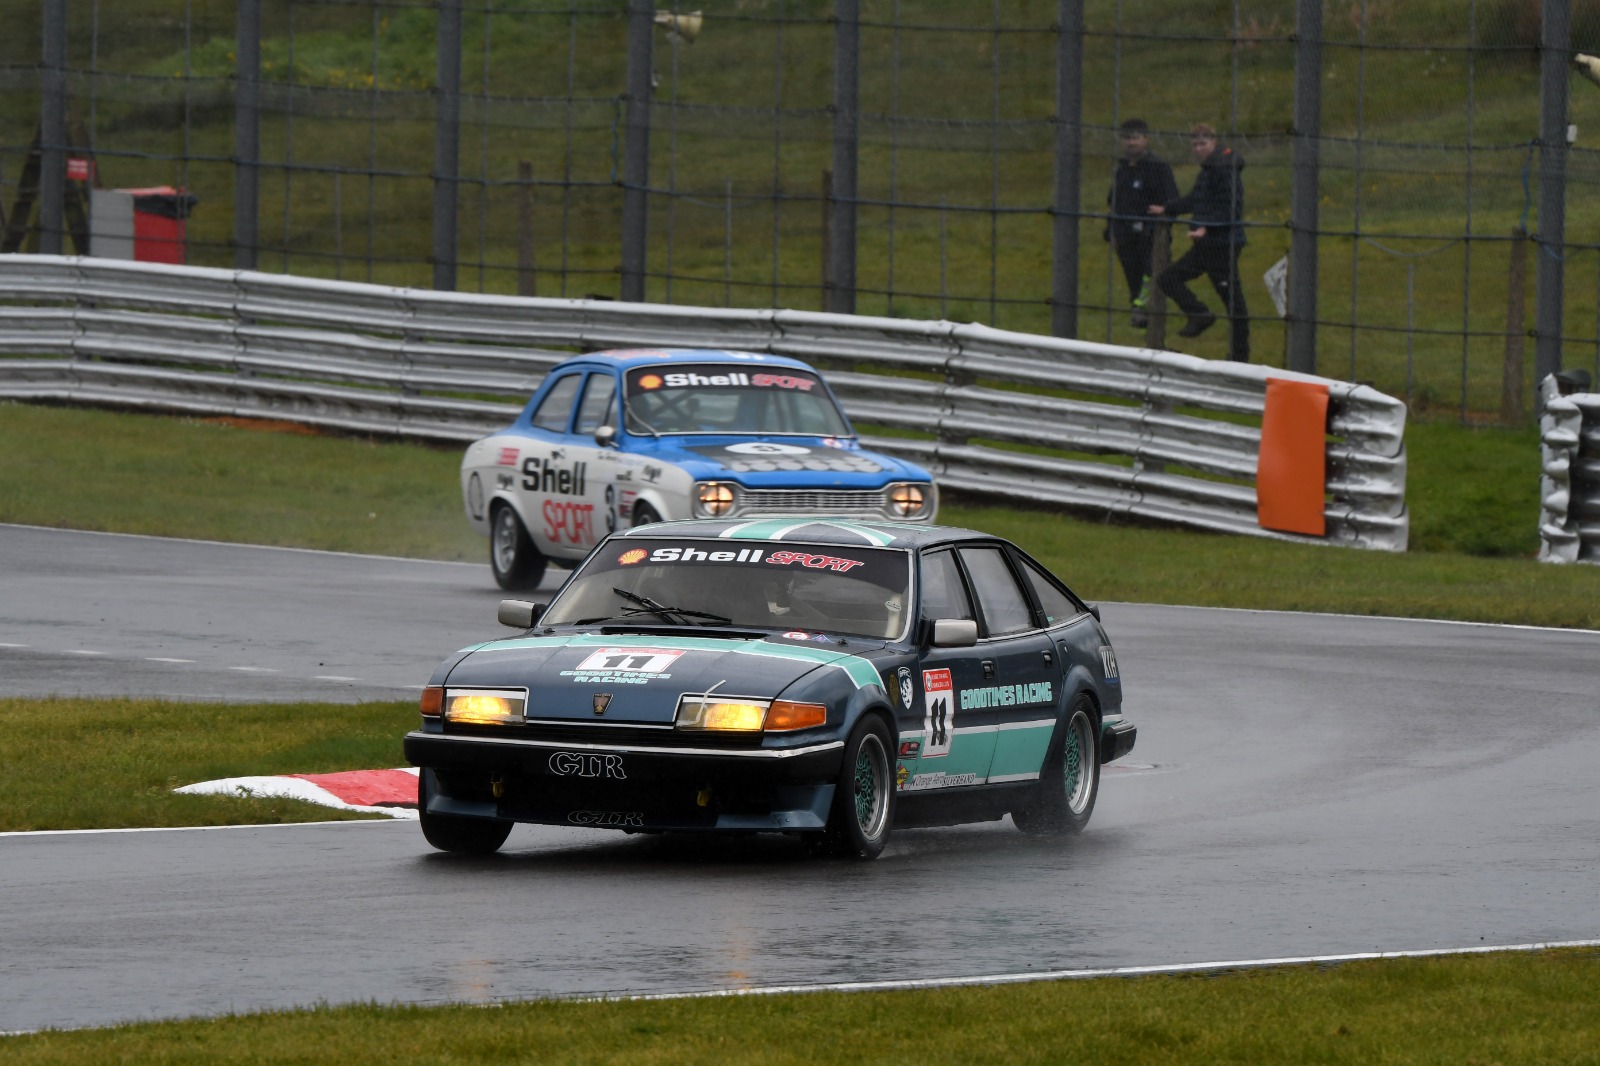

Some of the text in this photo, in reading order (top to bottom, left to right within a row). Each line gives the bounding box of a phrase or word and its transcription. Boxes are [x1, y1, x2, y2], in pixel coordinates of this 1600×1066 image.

[664, 373, 816, 391] Shell SPORT
[522, 457, 587, 496] Shell
[543, 499, 597, 545] SPORT
[650, 547, 865, 573] Shell SPORT
[560, 670, 672, 680] GOODTIMES
[602, 655, 655, 669] 11
[574, 676, 649, 684] RACING
[960, 681, 1053, 710] GOODTIMES RACING
[931, 697, 947, 746] 11
[548, 752, 627, 779] GTR
[567, 810, 644, 827] GTR
